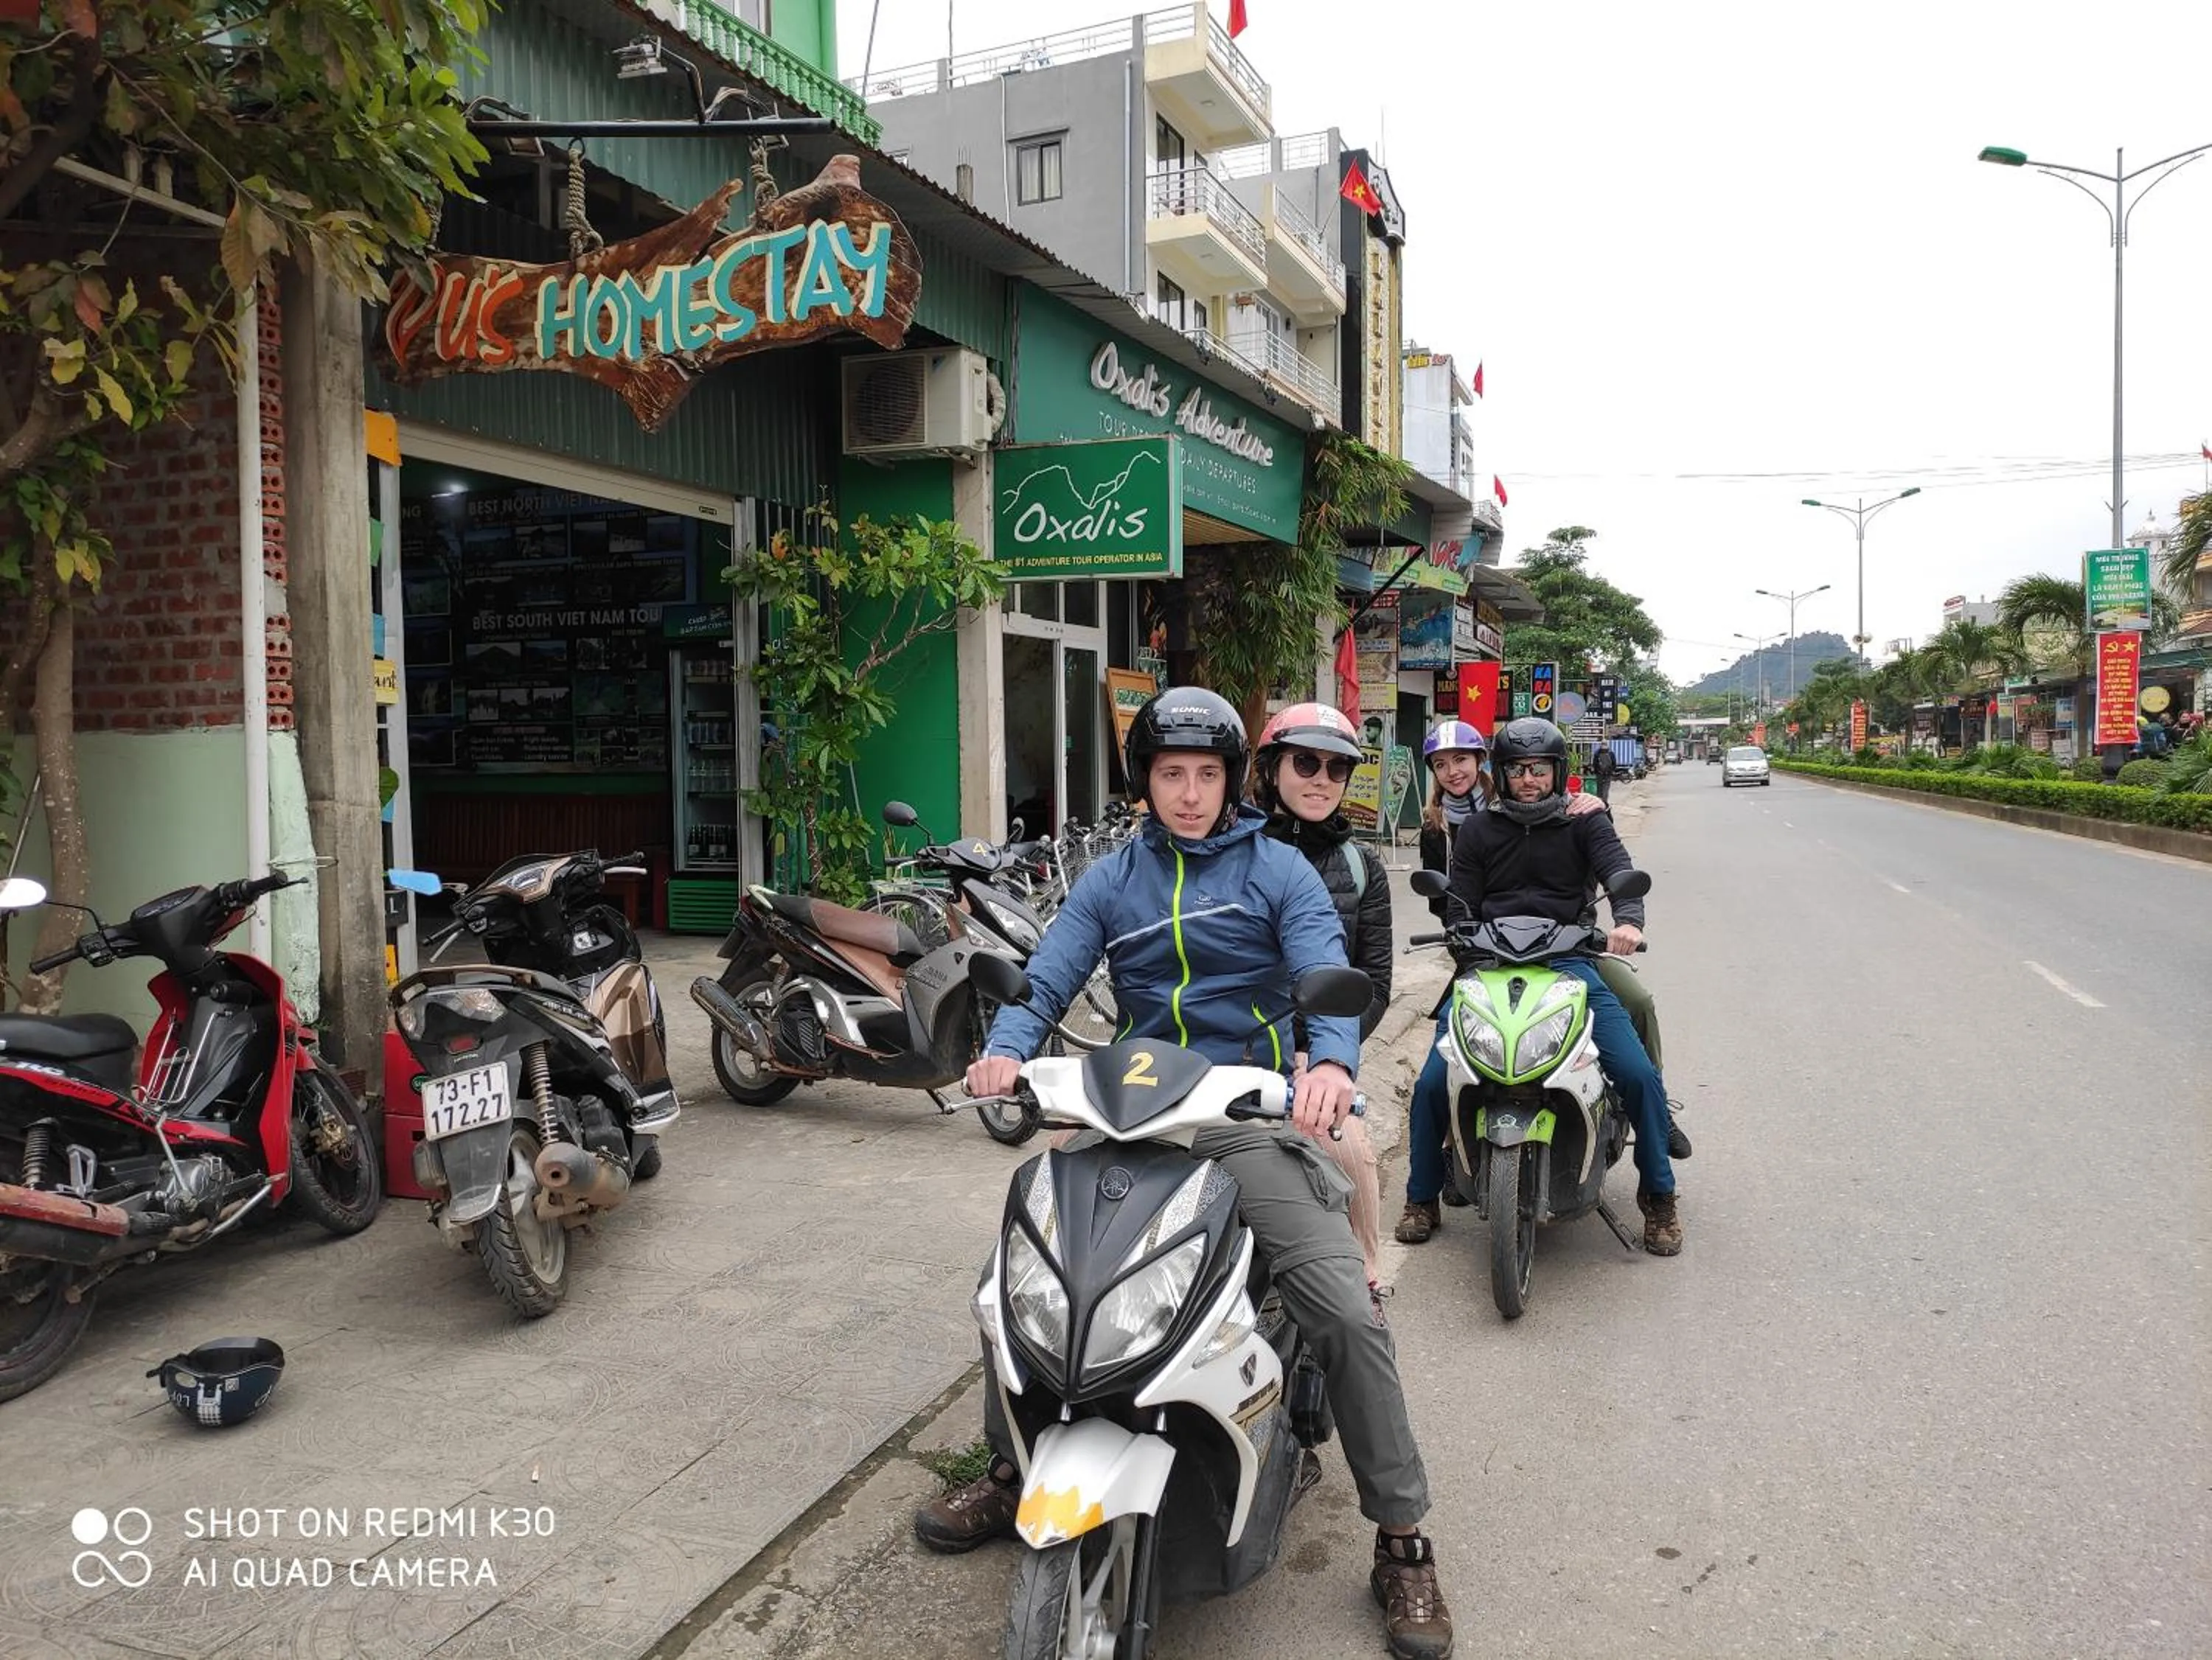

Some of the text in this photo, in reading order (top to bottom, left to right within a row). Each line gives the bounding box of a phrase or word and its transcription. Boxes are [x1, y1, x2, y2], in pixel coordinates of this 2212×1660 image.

[535, 217, 891, 362] HOMESTAY
[1091, 341, 1273, 467] Oxalis Adventure
[1099, 411, 1127, 436] TOUR
[1014, 499, 1148, 543] Oxalis
[1026, 557, 1071, 567] ADVENTURE
[1072, 555, 1094, 565] TOUR
[1095, 554, 1134, 564] OPERATOR
[1135, 553, 1144, 562] IN
[1144, 552, 1163, 562] ASIA
[473, 614, 502, 630] BEST
[507, 613, 553, 630] SOUTH
[557, 610, 585, 627] VIET
[590, 608, 625, 625] NAM
[628, 607, 661, 623] TOU
[436, 1070, 492, 1104] 73-F1
[1122, 1052, 1159, 1087] 2
[431, 1093, 503, 1133] 172.27
